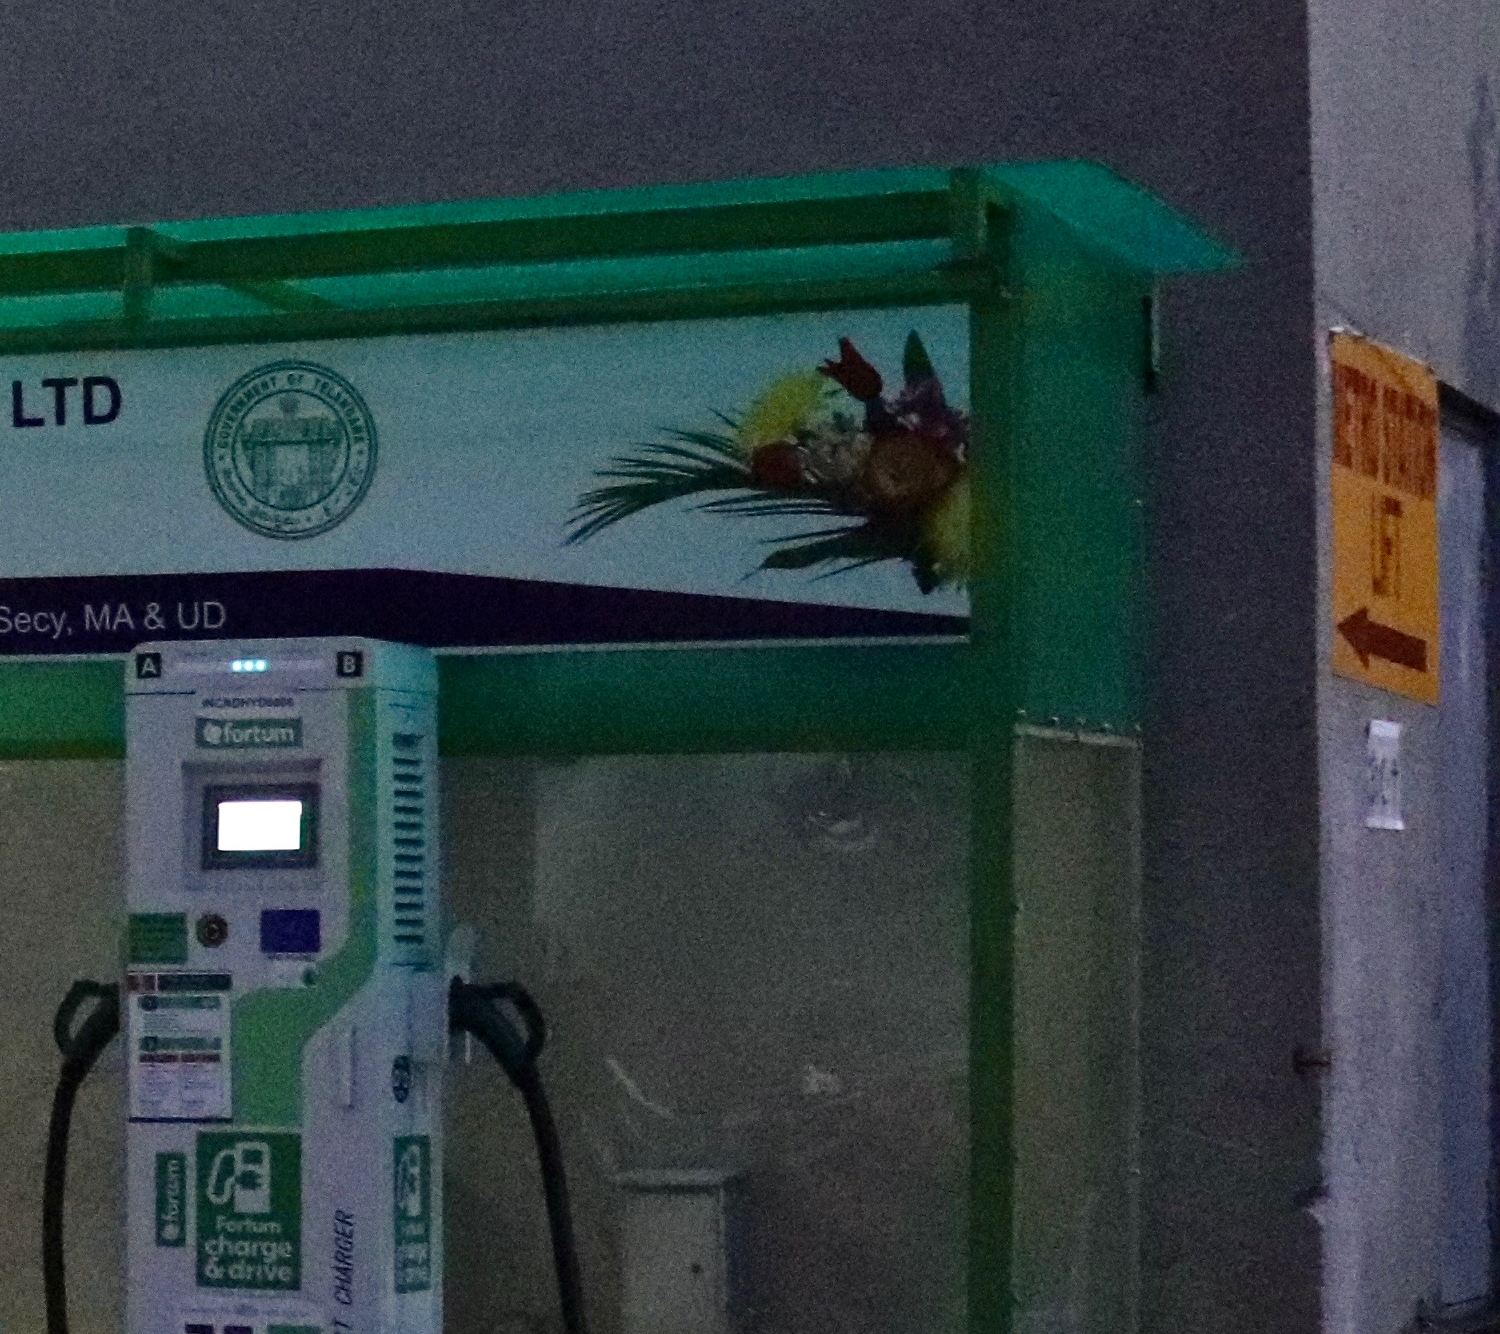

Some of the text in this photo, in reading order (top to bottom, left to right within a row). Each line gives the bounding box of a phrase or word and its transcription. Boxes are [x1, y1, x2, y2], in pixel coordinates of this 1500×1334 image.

[11, 376, 122, 427] LTD
[85, 604, 134, 631] MA
[145, 605, 167, 631] &
[177, 602, 227, 630] UD
[141, 657, 156, 675] A
[342, 654, 356, 673] B
[224, 721, 295, 743] fortum
[216, 1215, 281, 1234] Fortum
[204, 1234, 293, 1264] charge
[334, 1210, 354, 1304] CHARGER
[204, 1256, 293, 1281] & drive
